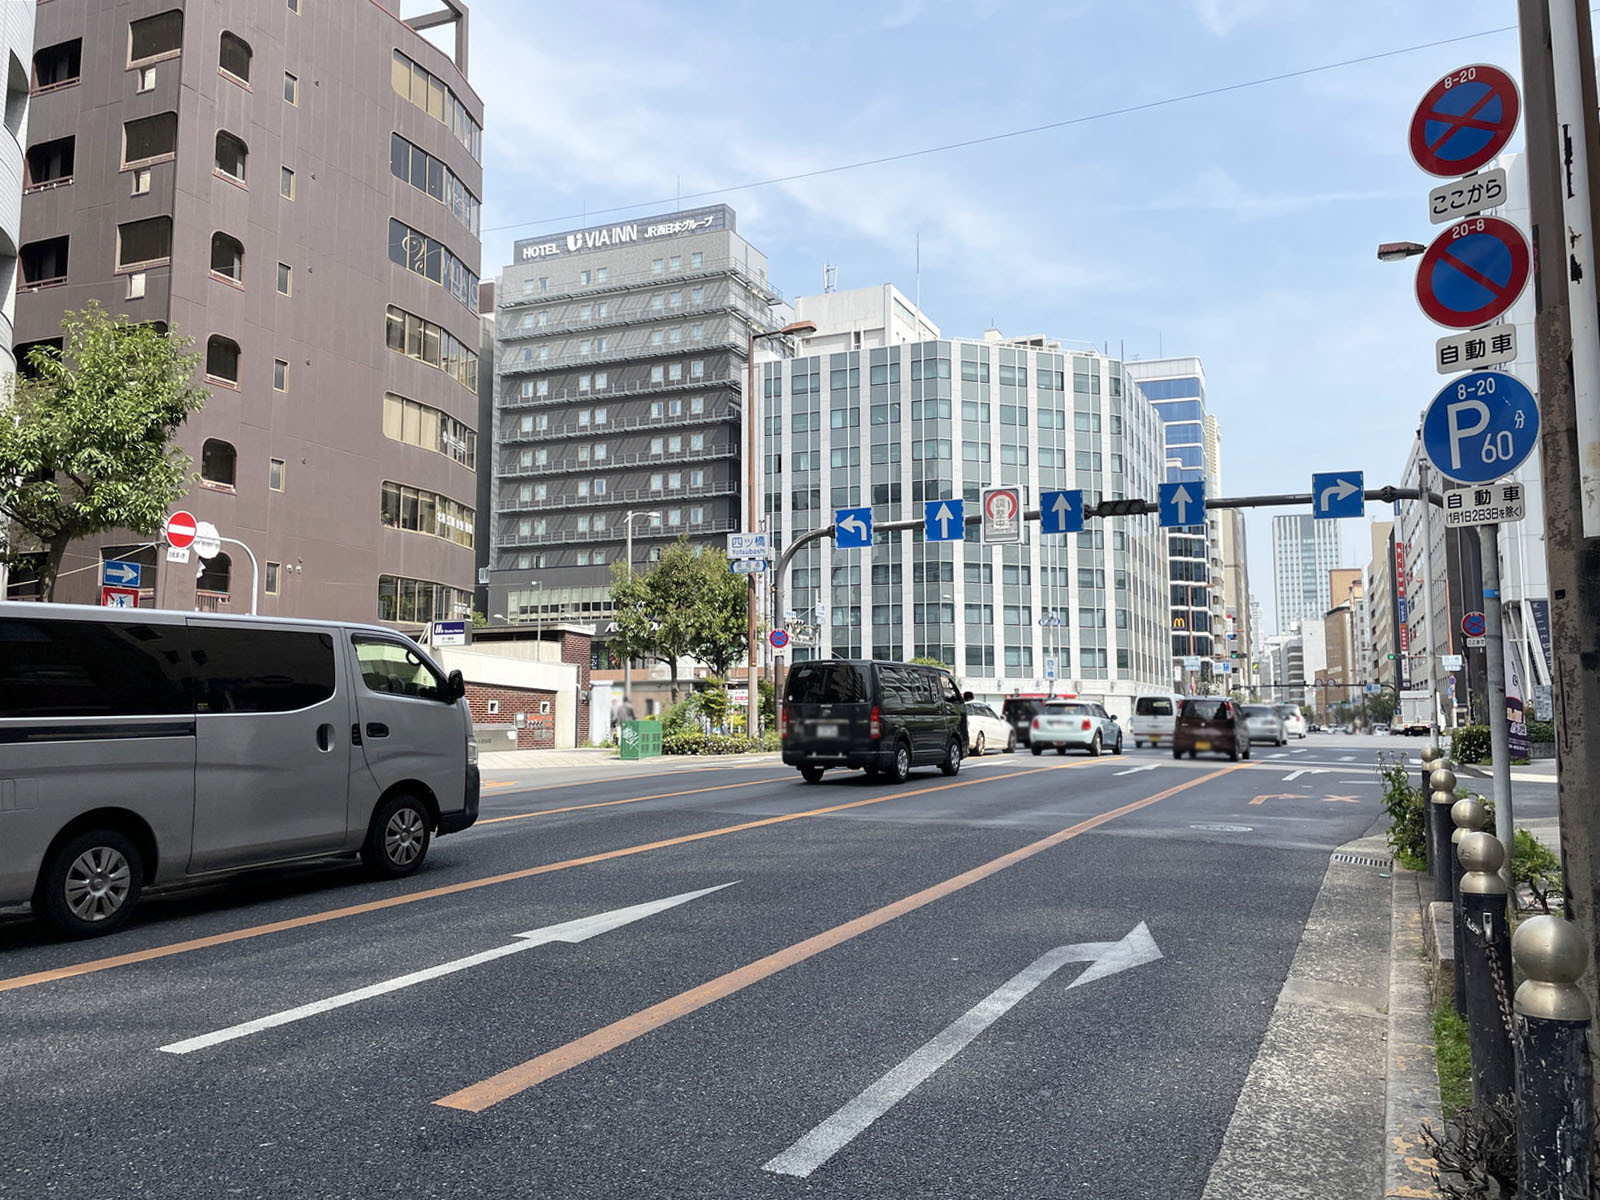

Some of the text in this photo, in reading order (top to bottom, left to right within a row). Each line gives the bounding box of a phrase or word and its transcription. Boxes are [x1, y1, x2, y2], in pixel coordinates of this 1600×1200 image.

[1444, 67, 1477, 89] 8-20
[1433, 179, 1502, 214] ここから
[644, 215, 714, 238] JR西日本グループ
[1451, 219, 1486, 239] 20-8
[522, 243, 561, 259] HOTEL
[1440, 333, 1513, 365] 自動車
[1457, 377, 1496, 400] 8-20
[1446, 399, 1514, 470] P 60
[1447, 485, 1521, 509] 自動車
[731, 536, 766, 548] 四ツ橋
